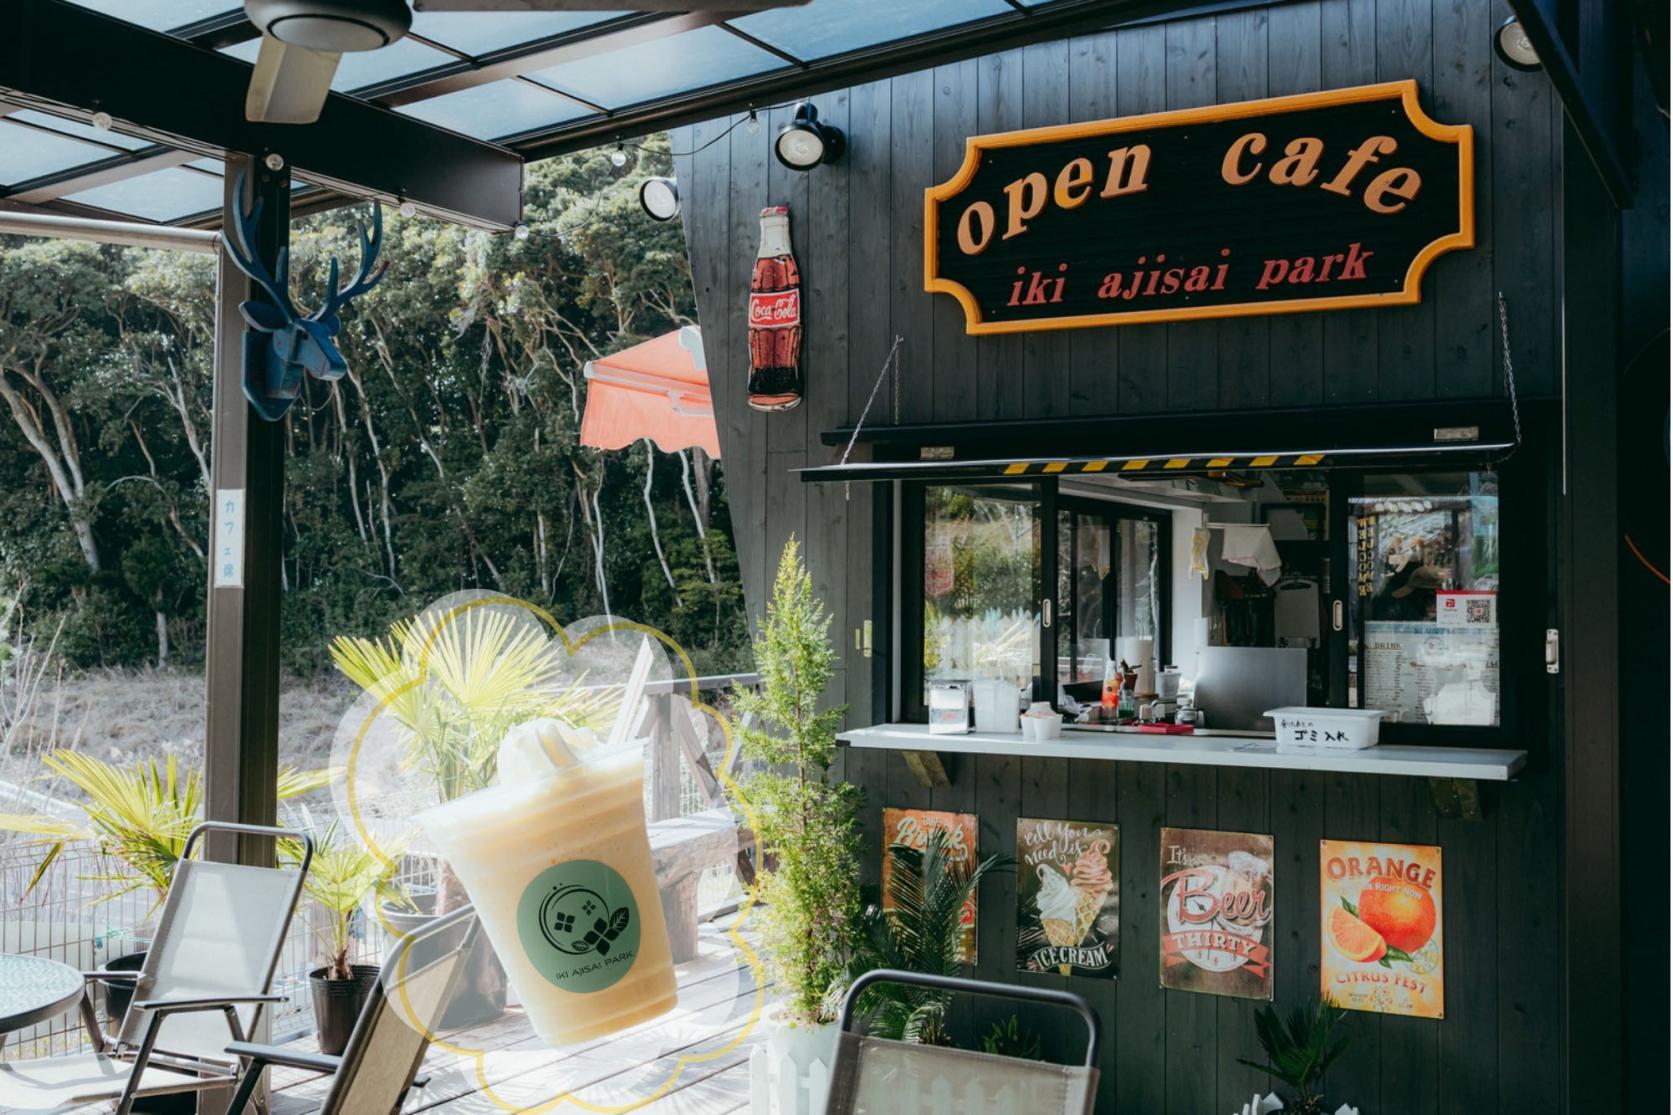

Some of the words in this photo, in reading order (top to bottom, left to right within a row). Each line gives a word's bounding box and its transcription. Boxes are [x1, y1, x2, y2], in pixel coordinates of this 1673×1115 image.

[957, 143, 1152, 256] open
[1222, 131, 1422, 215] cafe
[1007, 263, 1068, 307] iki
[1098, 249, 1231, 300] ajisai
[1256, 243, 1375, 290] park
[750, 294, 798, 323] Coca-Cola
[1055, 821, 1104, 841] You
[1024, 846, 1066, 866] need
[1066, 843, 1090, 858] is
[1326, 856, 1437, 889] ORANGE
[1164, 867, 1272, 924] Beer
[1374, 882, 1399, 895] RIGHT
[1172, 930, 1257, 956] THIRTY
[556, 969, 569, 980] IKI
[571, 962, 602, 977] AJISAI
[604, 951, 634, 967] PARK
[1033, 949, 1060, 971] ICE
[1061, 946, 1108, 968] CREAM
[1336, 968, 1389, 985] CITRUS
[1394, 974, 1428, 994] FEST
